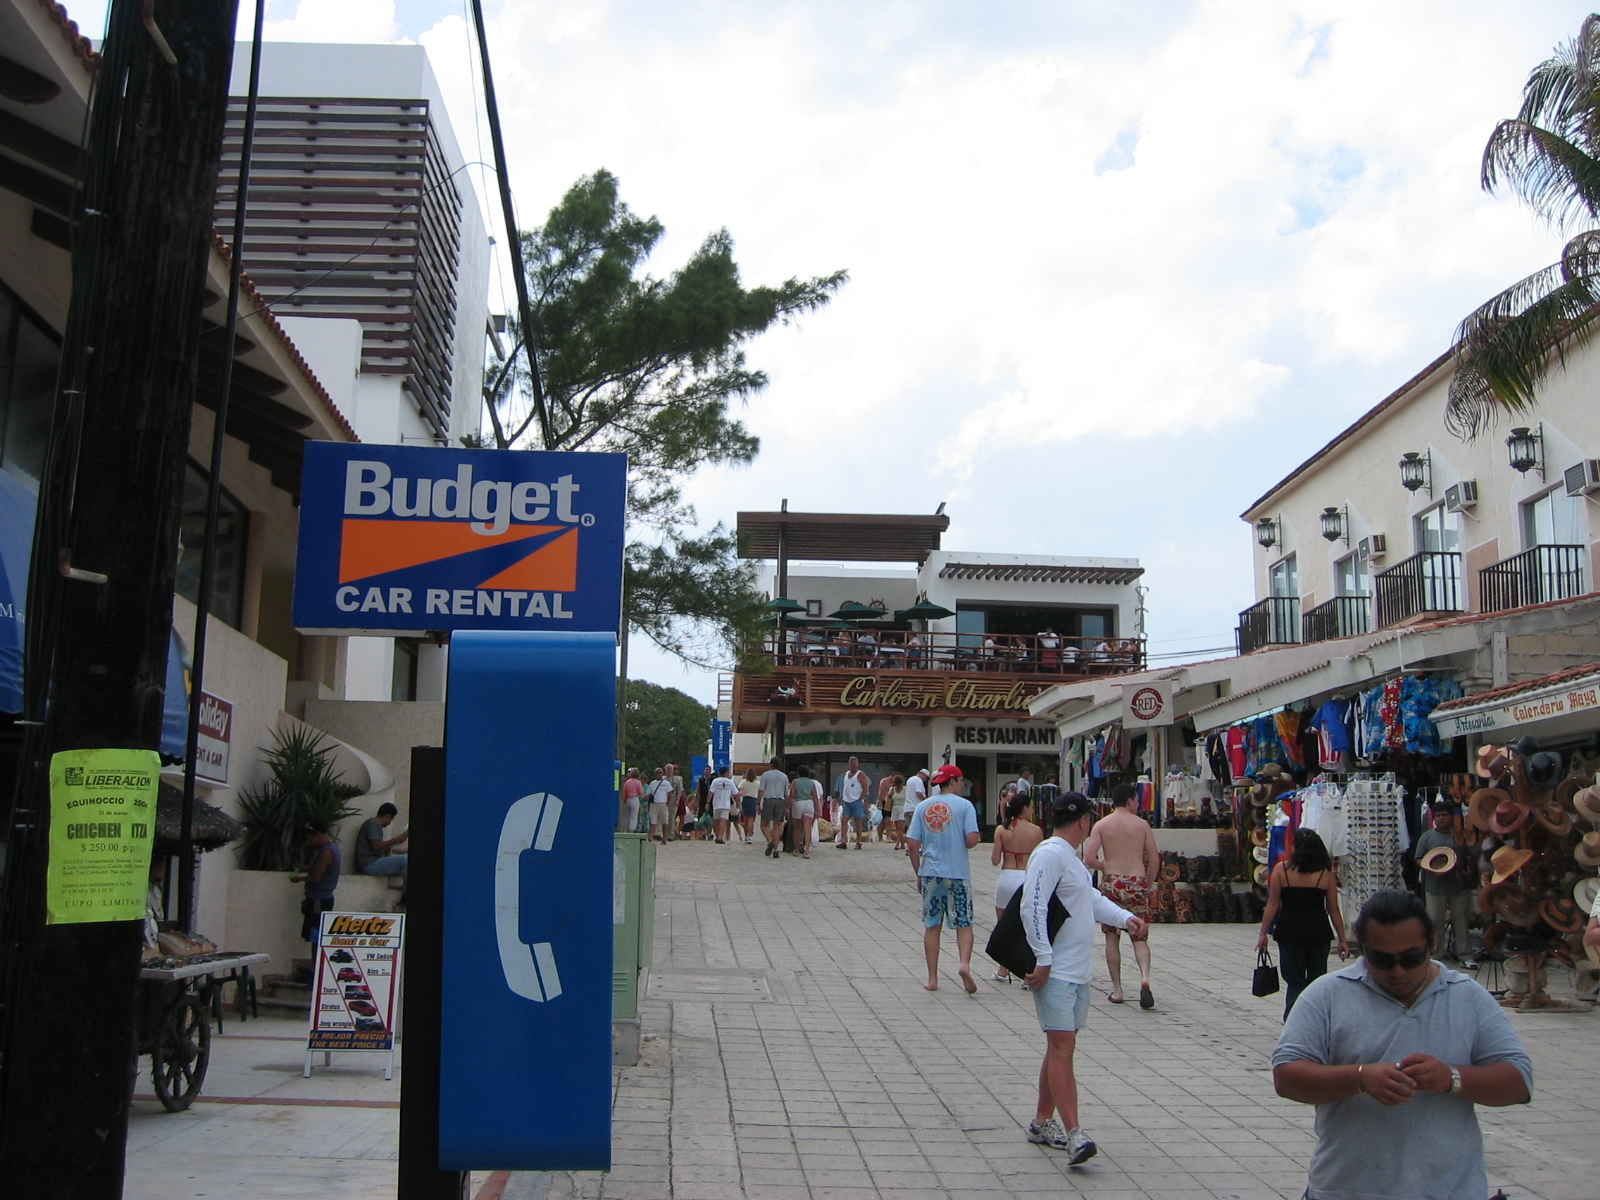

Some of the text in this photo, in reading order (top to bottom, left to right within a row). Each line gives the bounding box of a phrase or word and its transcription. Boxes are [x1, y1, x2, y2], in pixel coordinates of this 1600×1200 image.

[344, 460, 580, 536] Budget
[336, 586, 573, 619] CAR RENTAL
[1137, 696, 1157, 711] RED
[199, 697, 228, 737] oliday
[955, 726, 1057, 745] RESTAURANT
[211, 752, 222, 766] CAR
[85, 775, 151, 787] LIBERACION
[66, 798, 125, 810] EQUINOCCIO
[67, 823, 147, 839] CHICHEN ITZA
[81, 844, 87, 852] $
[89, 843, 119, 852] 250.00
[65, 900, 93, 908] CUPO
[328, 916, 396, 936] Hertz
[330, 937, 357, 946] Rent
[369, 938, 390, 947] Car
[321, 1032, 351, 1040] MEJOR
